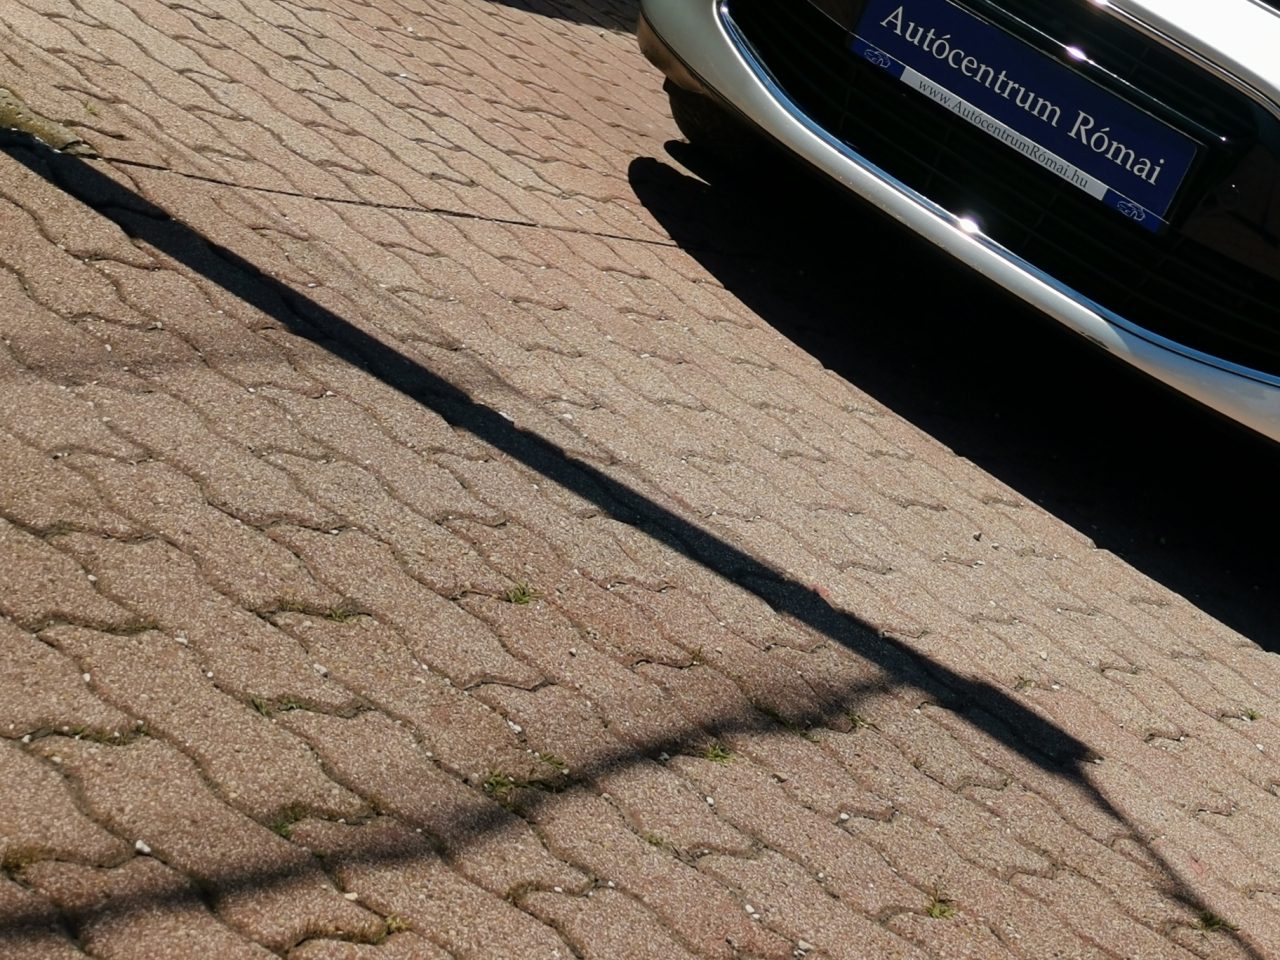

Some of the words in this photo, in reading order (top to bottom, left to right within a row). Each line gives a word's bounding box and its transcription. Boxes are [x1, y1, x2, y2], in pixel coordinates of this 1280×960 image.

[880, 6, 1062, 128] Autócentrum
[1067, 110, 1165, 186] Római
[918, 79, 1089, 190] www.AutócentrumRómai.hu
